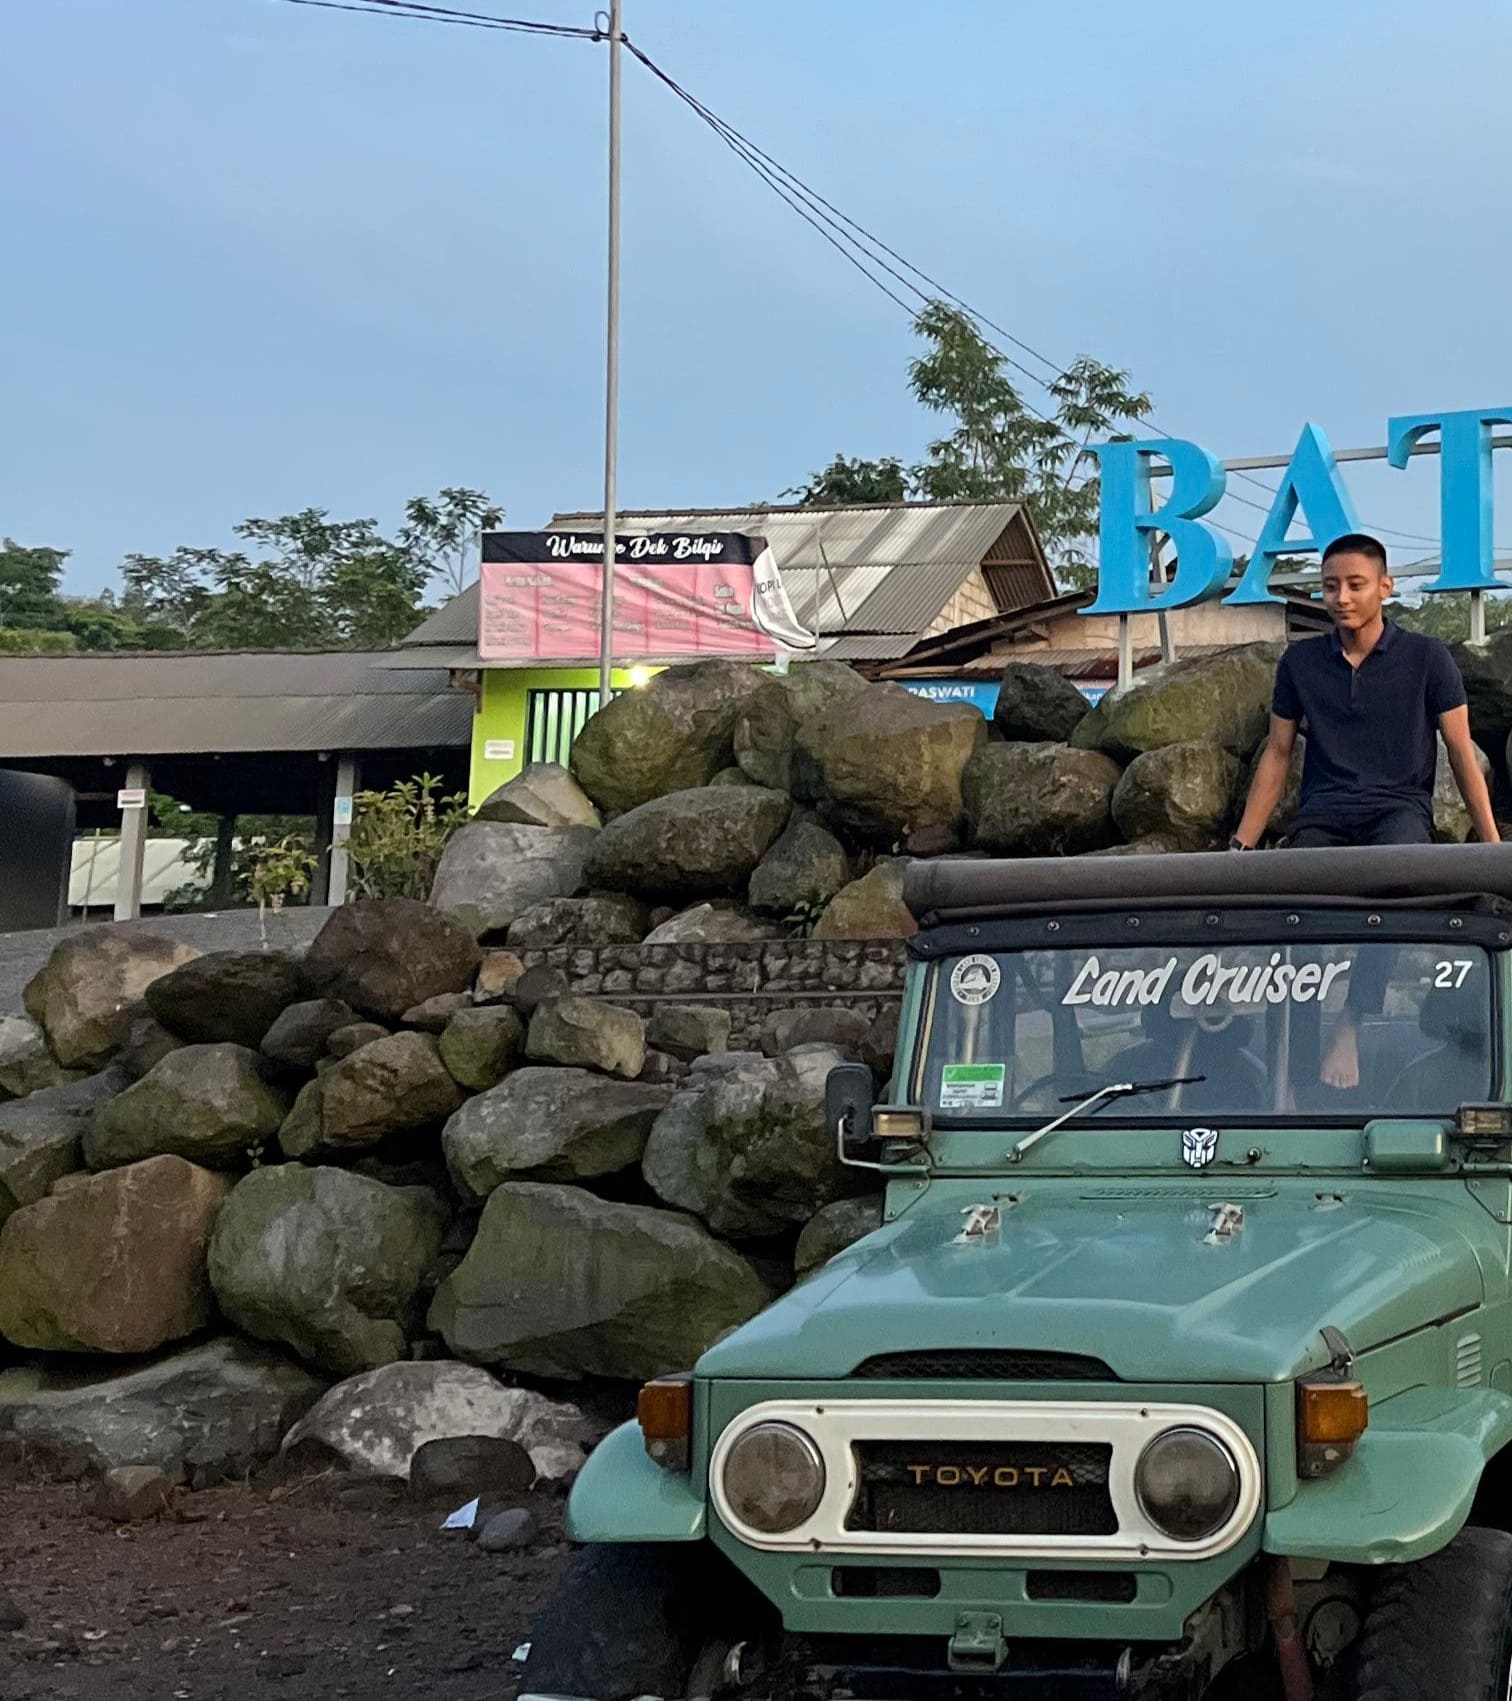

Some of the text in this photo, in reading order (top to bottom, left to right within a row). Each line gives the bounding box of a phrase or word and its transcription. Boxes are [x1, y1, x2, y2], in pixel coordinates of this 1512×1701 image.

[629, 537, 668, 558] Dek
[1062, 953, 1351, 1006] Land Cruiser
[1434, 960, 1473, 988] 27
[907, 1465, 1074, 1487] TOYOTA
